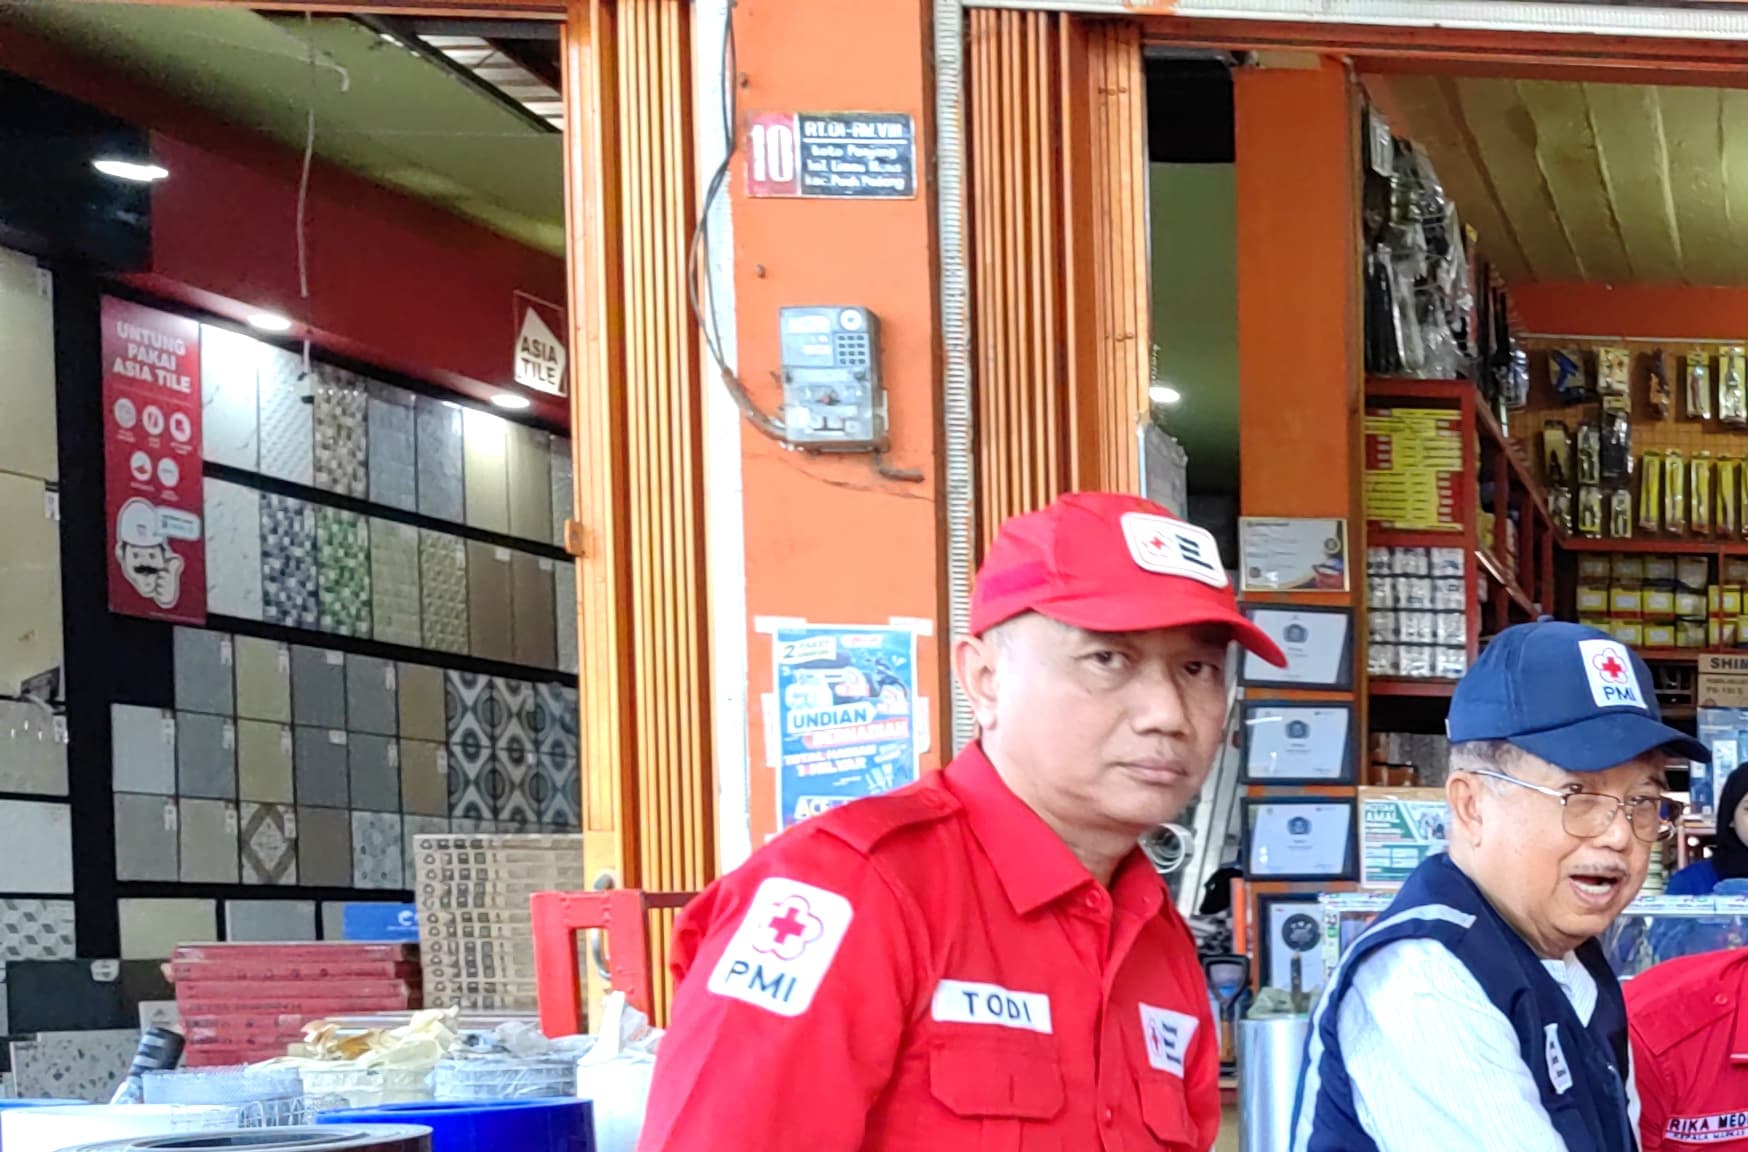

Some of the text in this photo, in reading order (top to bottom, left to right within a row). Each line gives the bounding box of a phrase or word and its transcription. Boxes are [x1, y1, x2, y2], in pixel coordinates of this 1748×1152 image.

[751, 124, 793, 181] 10
[117, 321, 186, 356] UNTUNG
[521, 336, 558, 365] ASIA
[128, 343, 176, 370] PAKAI
[520, 357, 556, 385] TILE
[112, 357, 192, 394] ASIA TILE
[783, 645, 795, 658] 2
[1603, 686, 1637, 701] PMI
[793, 708, 867, 729] UNDIAN
[725, 960, 797, 1002] PMI
[962, 991, 1031, 1023] TODI
